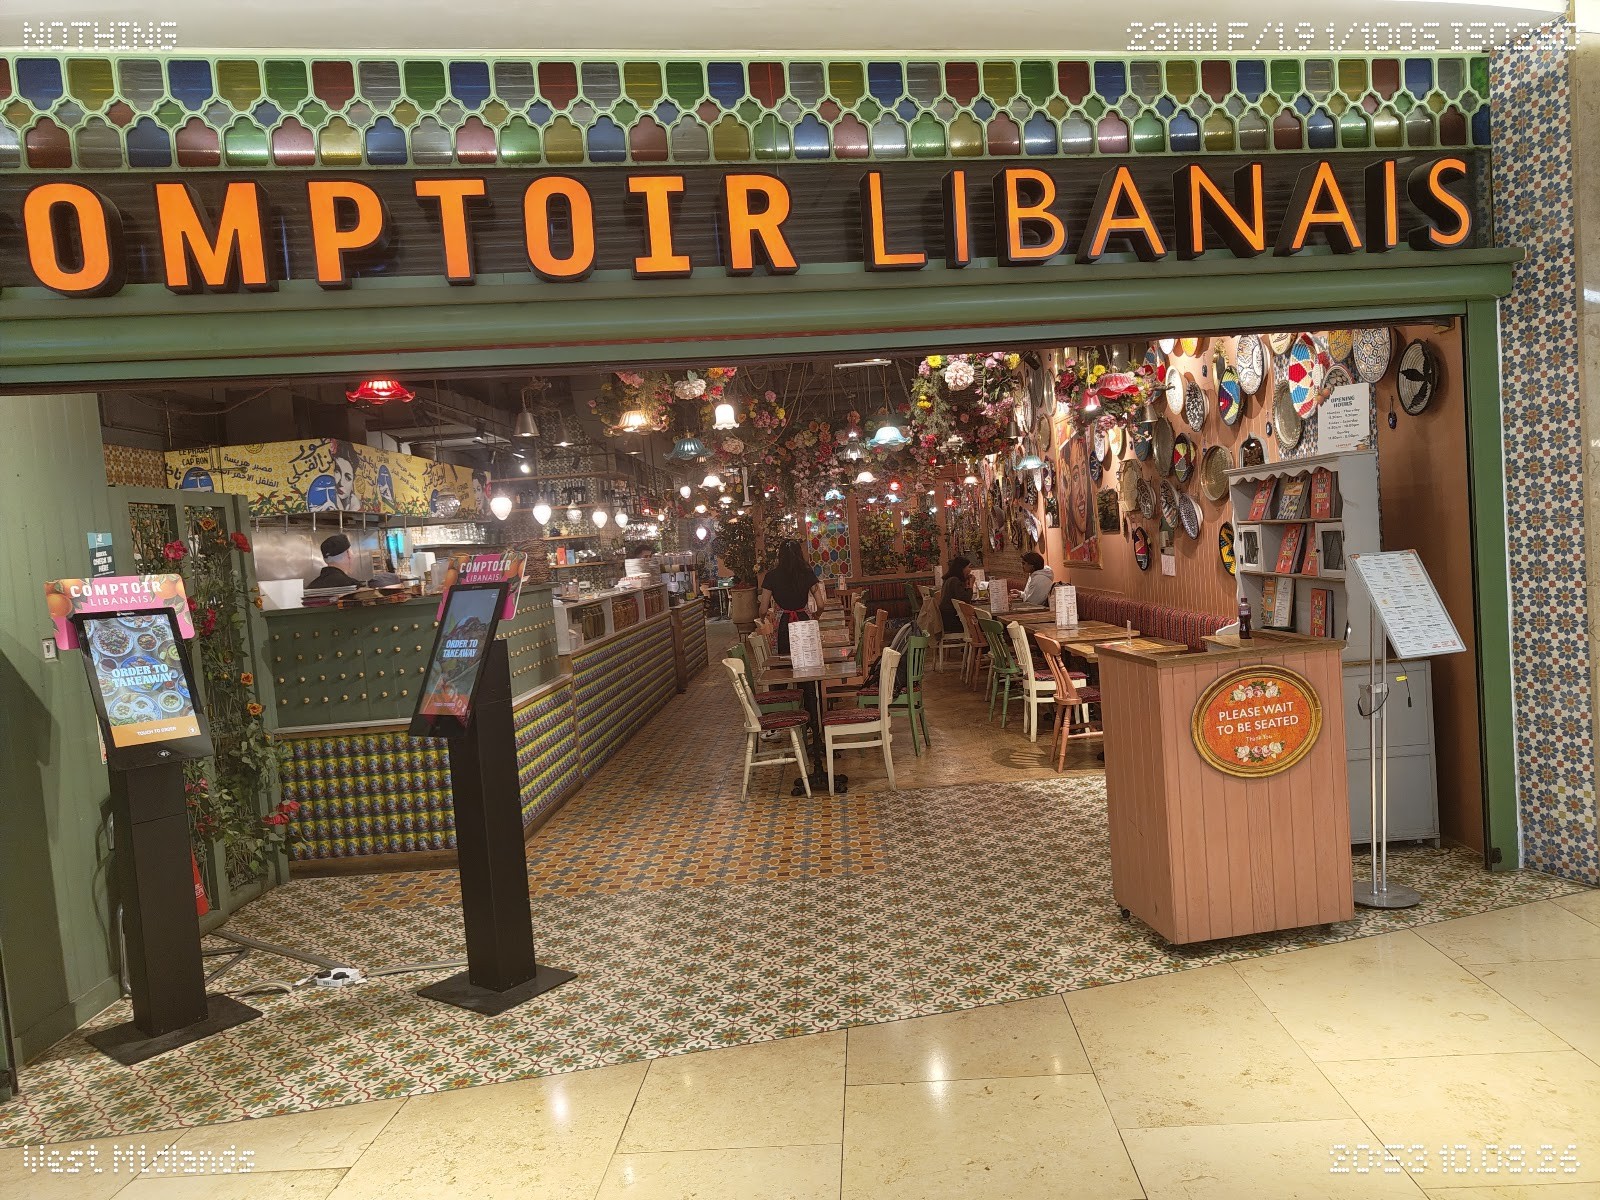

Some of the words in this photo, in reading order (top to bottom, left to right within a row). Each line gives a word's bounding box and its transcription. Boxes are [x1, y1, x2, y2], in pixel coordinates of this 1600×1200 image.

[22, 171, 798, 291] OMPTOIR
[864, 157, 1473, 272] LIBANAIS
[459, 559, 512, 574] COMPTOIR
[466, 573, 500, 583] LIBANAIS
[70, 580, 163, 598] COMPTOIR
[89, 595, 149, 607] LIBANAIS
[445, 640, 469, 649] ORDER
[469, 639, 479, 648] TO
[442, 649, 478, 658] TAKEAWAY
[111, 665, 151, 678] ORDER
[154, 663, 169, 673] TO
[111, 672, 174, 688] TAKEAWAY
[1218, 706, 1261, 722] PLEASE
[1262, 701, 1294, 715] WAIT
[1216, 724, 1234, 736] TO
[1237, 722, 1251, 733] BE
[1254, 715, 1299, 731] SEATED
